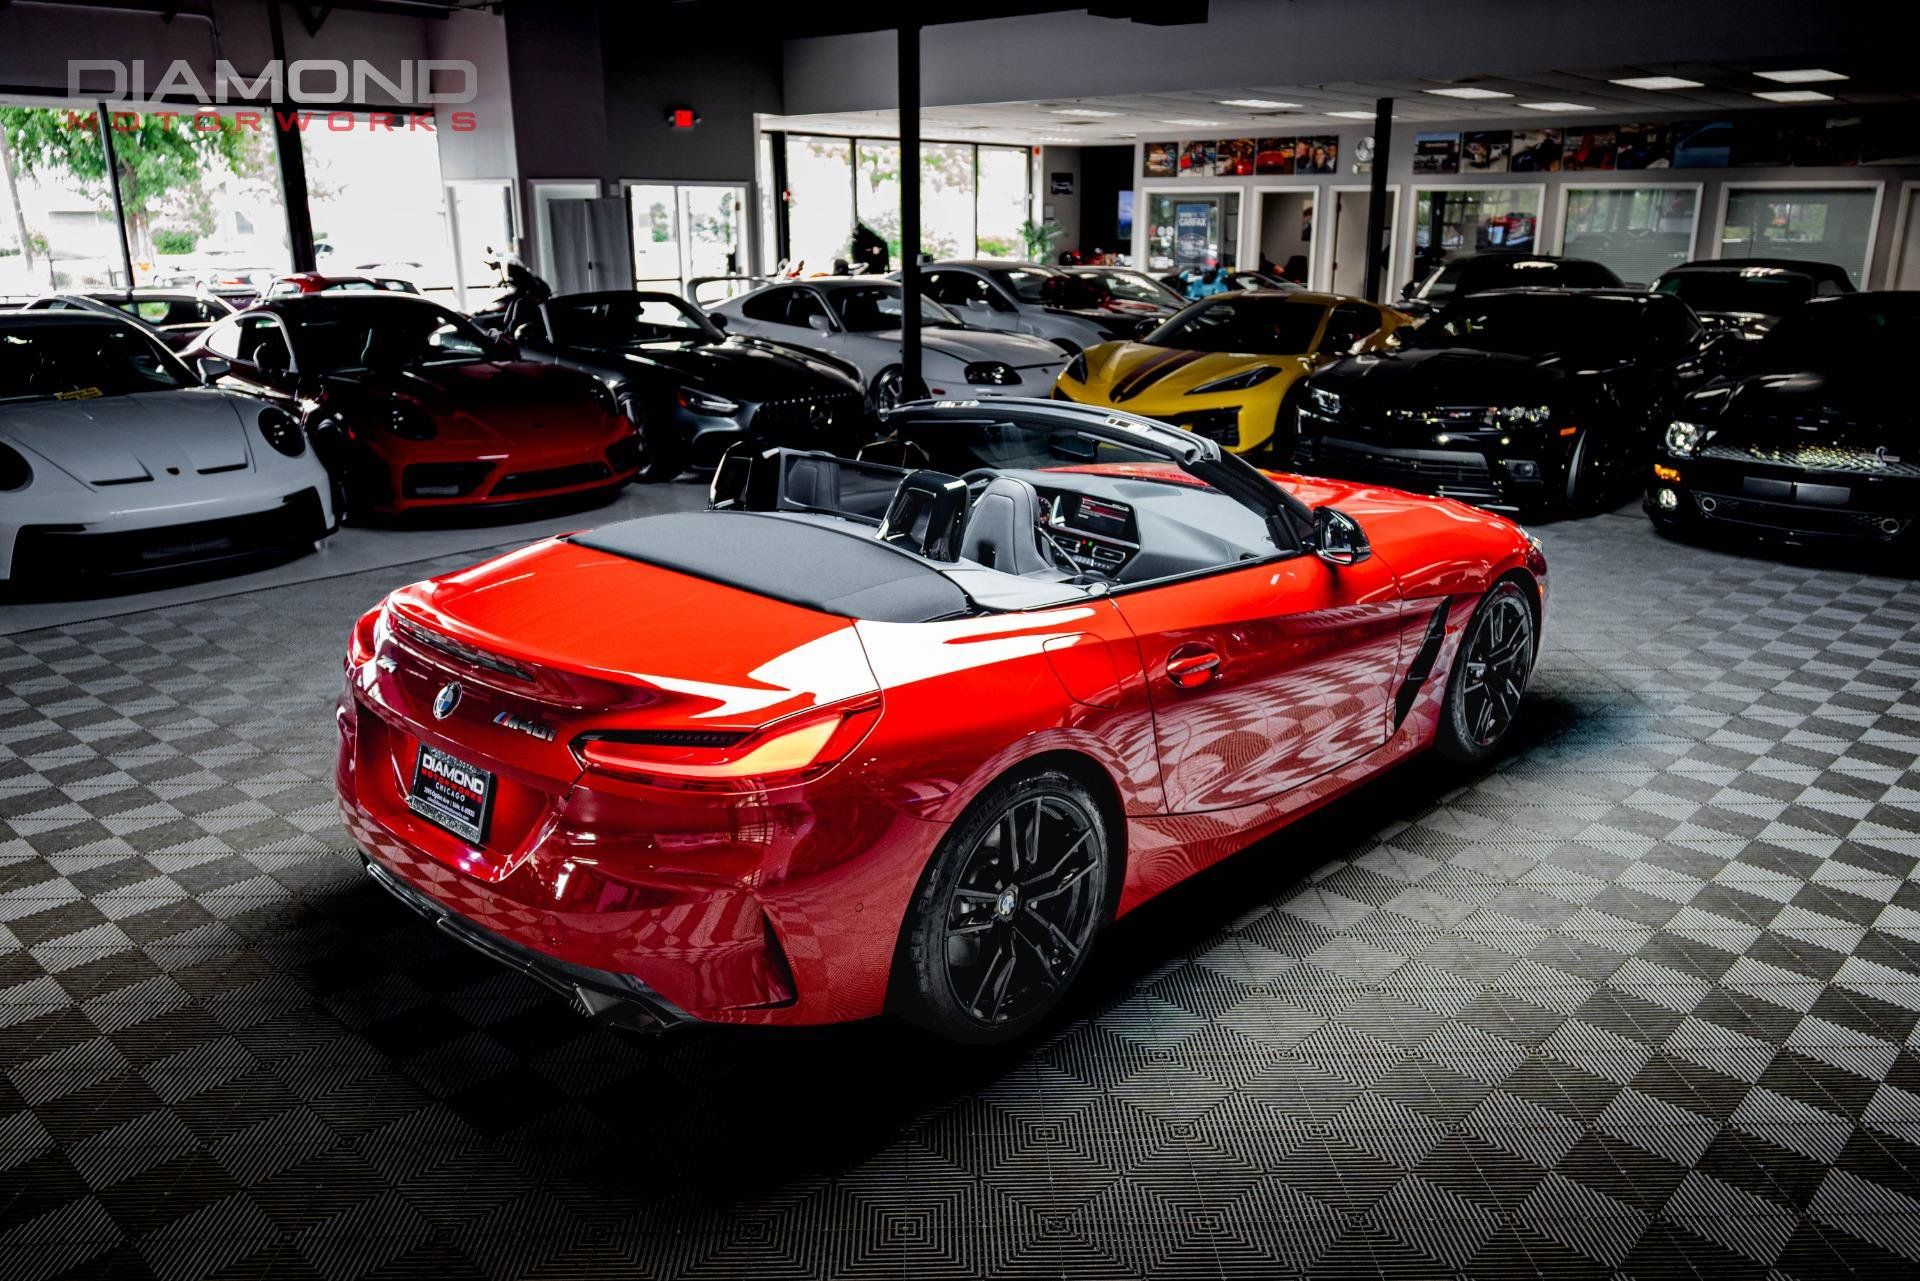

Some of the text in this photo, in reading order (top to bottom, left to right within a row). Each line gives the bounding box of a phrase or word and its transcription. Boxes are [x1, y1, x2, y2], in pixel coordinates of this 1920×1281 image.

[421, 767, 484, 804] MOTORWORKS
[422, 753, 484, 795] DIAMOND
[435, 782, 466, 802] CHICAGO
